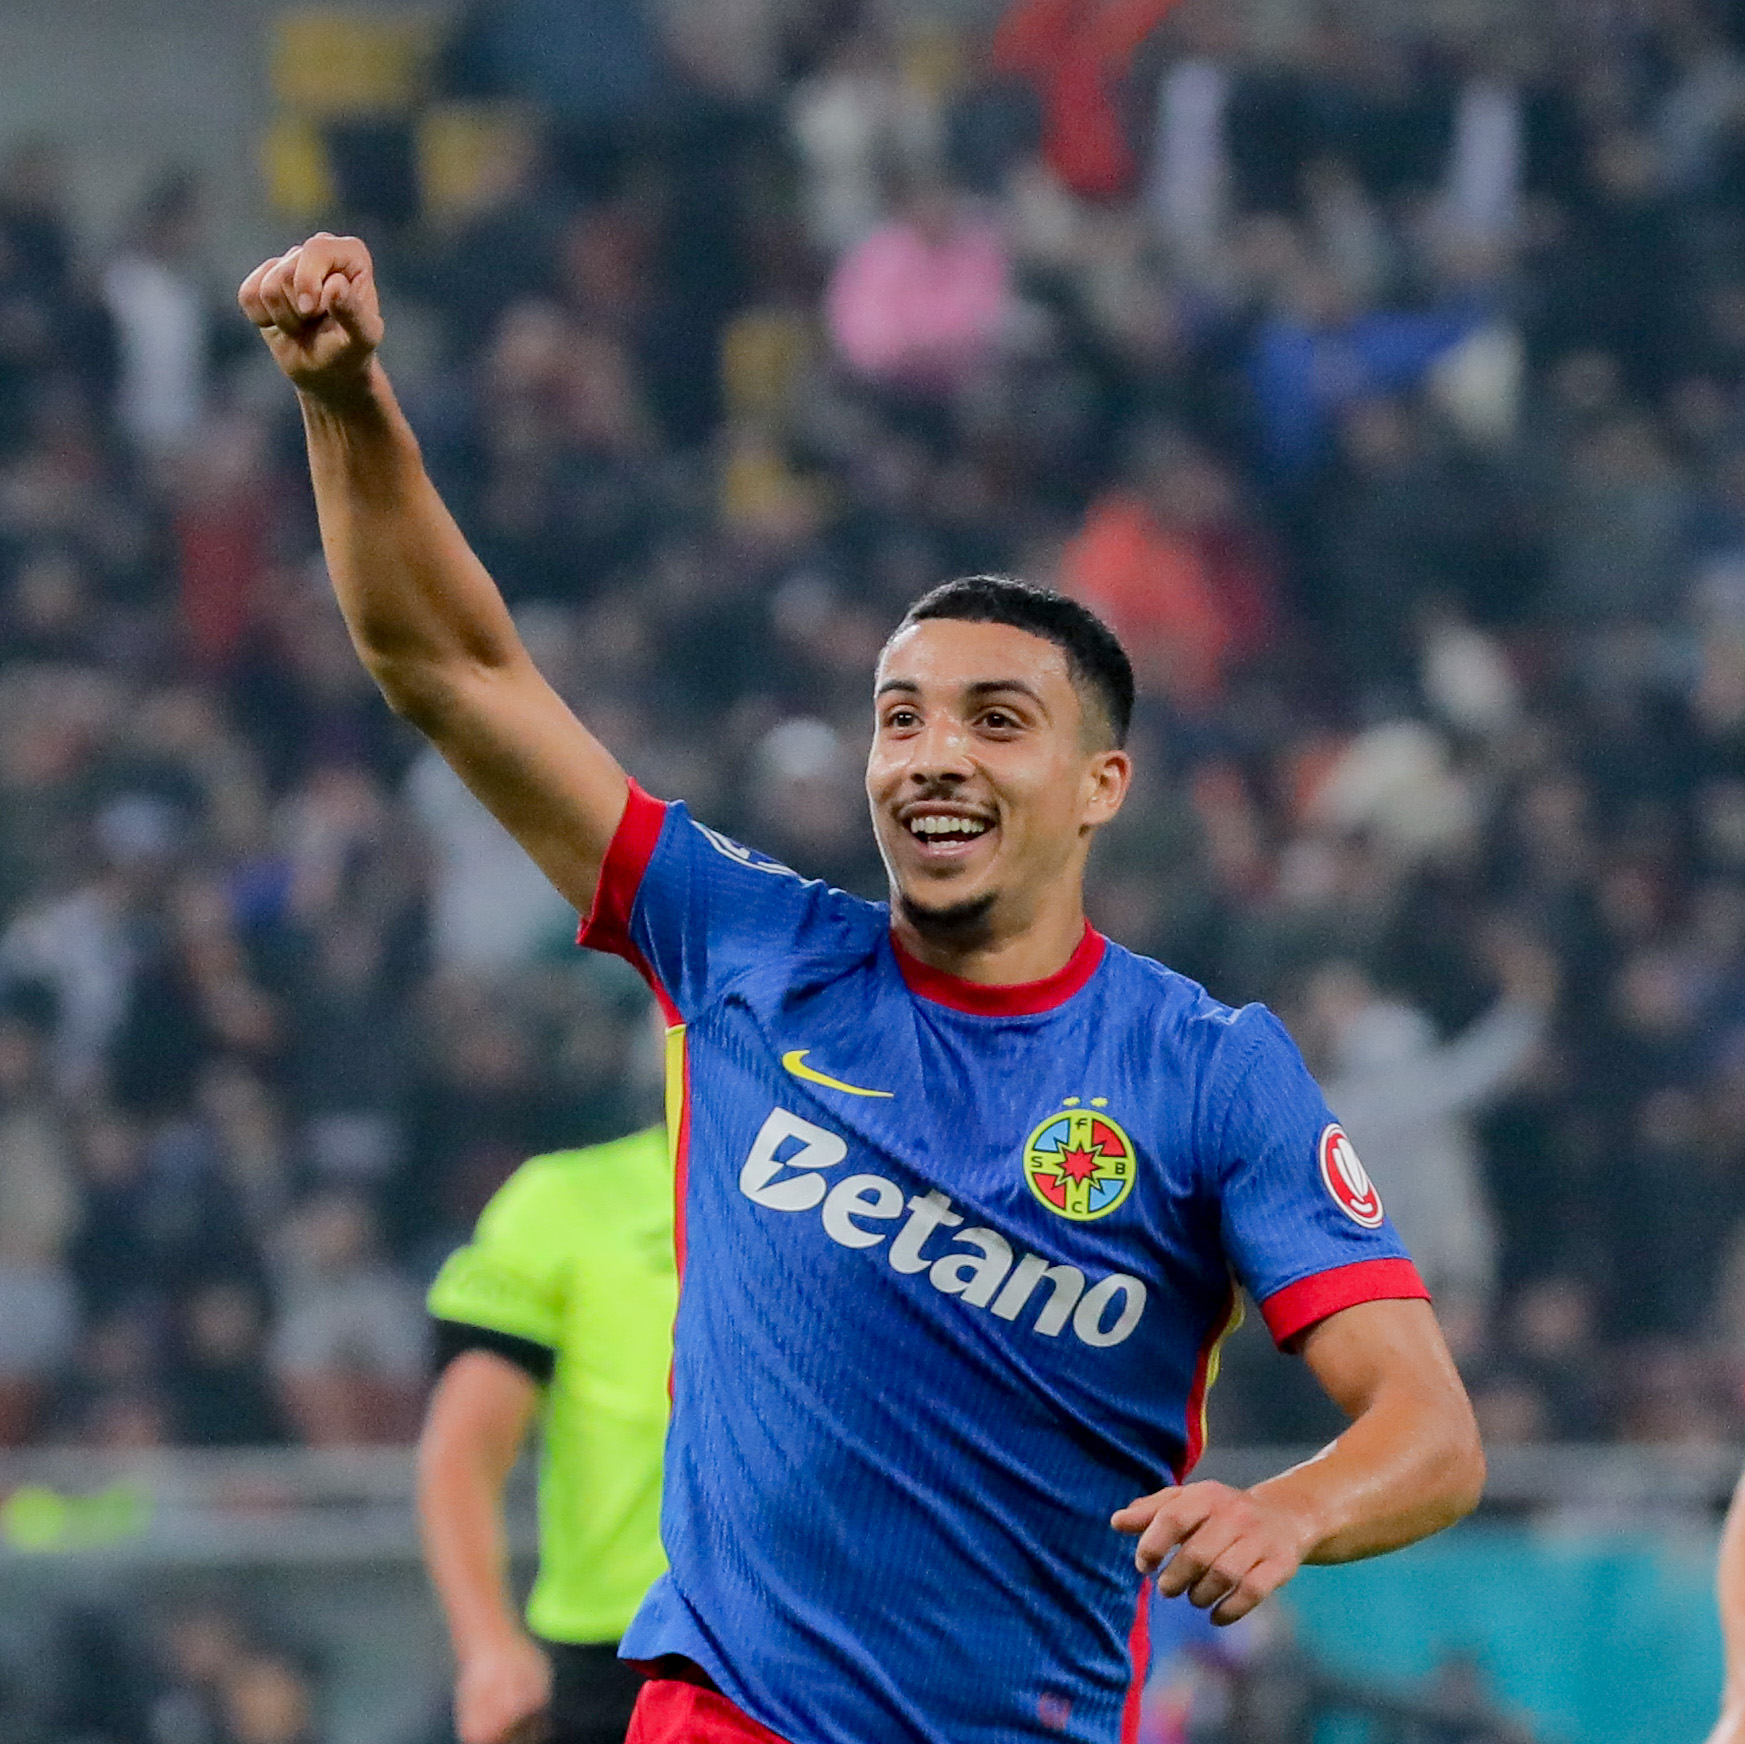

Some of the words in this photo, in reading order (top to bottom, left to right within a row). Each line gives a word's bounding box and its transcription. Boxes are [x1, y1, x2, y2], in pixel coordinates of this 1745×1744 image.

[1030, 1155, 1044, 1169] S
[1114, 1161, 1126, 1175] B
[1071, 1200, 1084, 1213] C
[739, 1107, 1147, 1348] Betano
